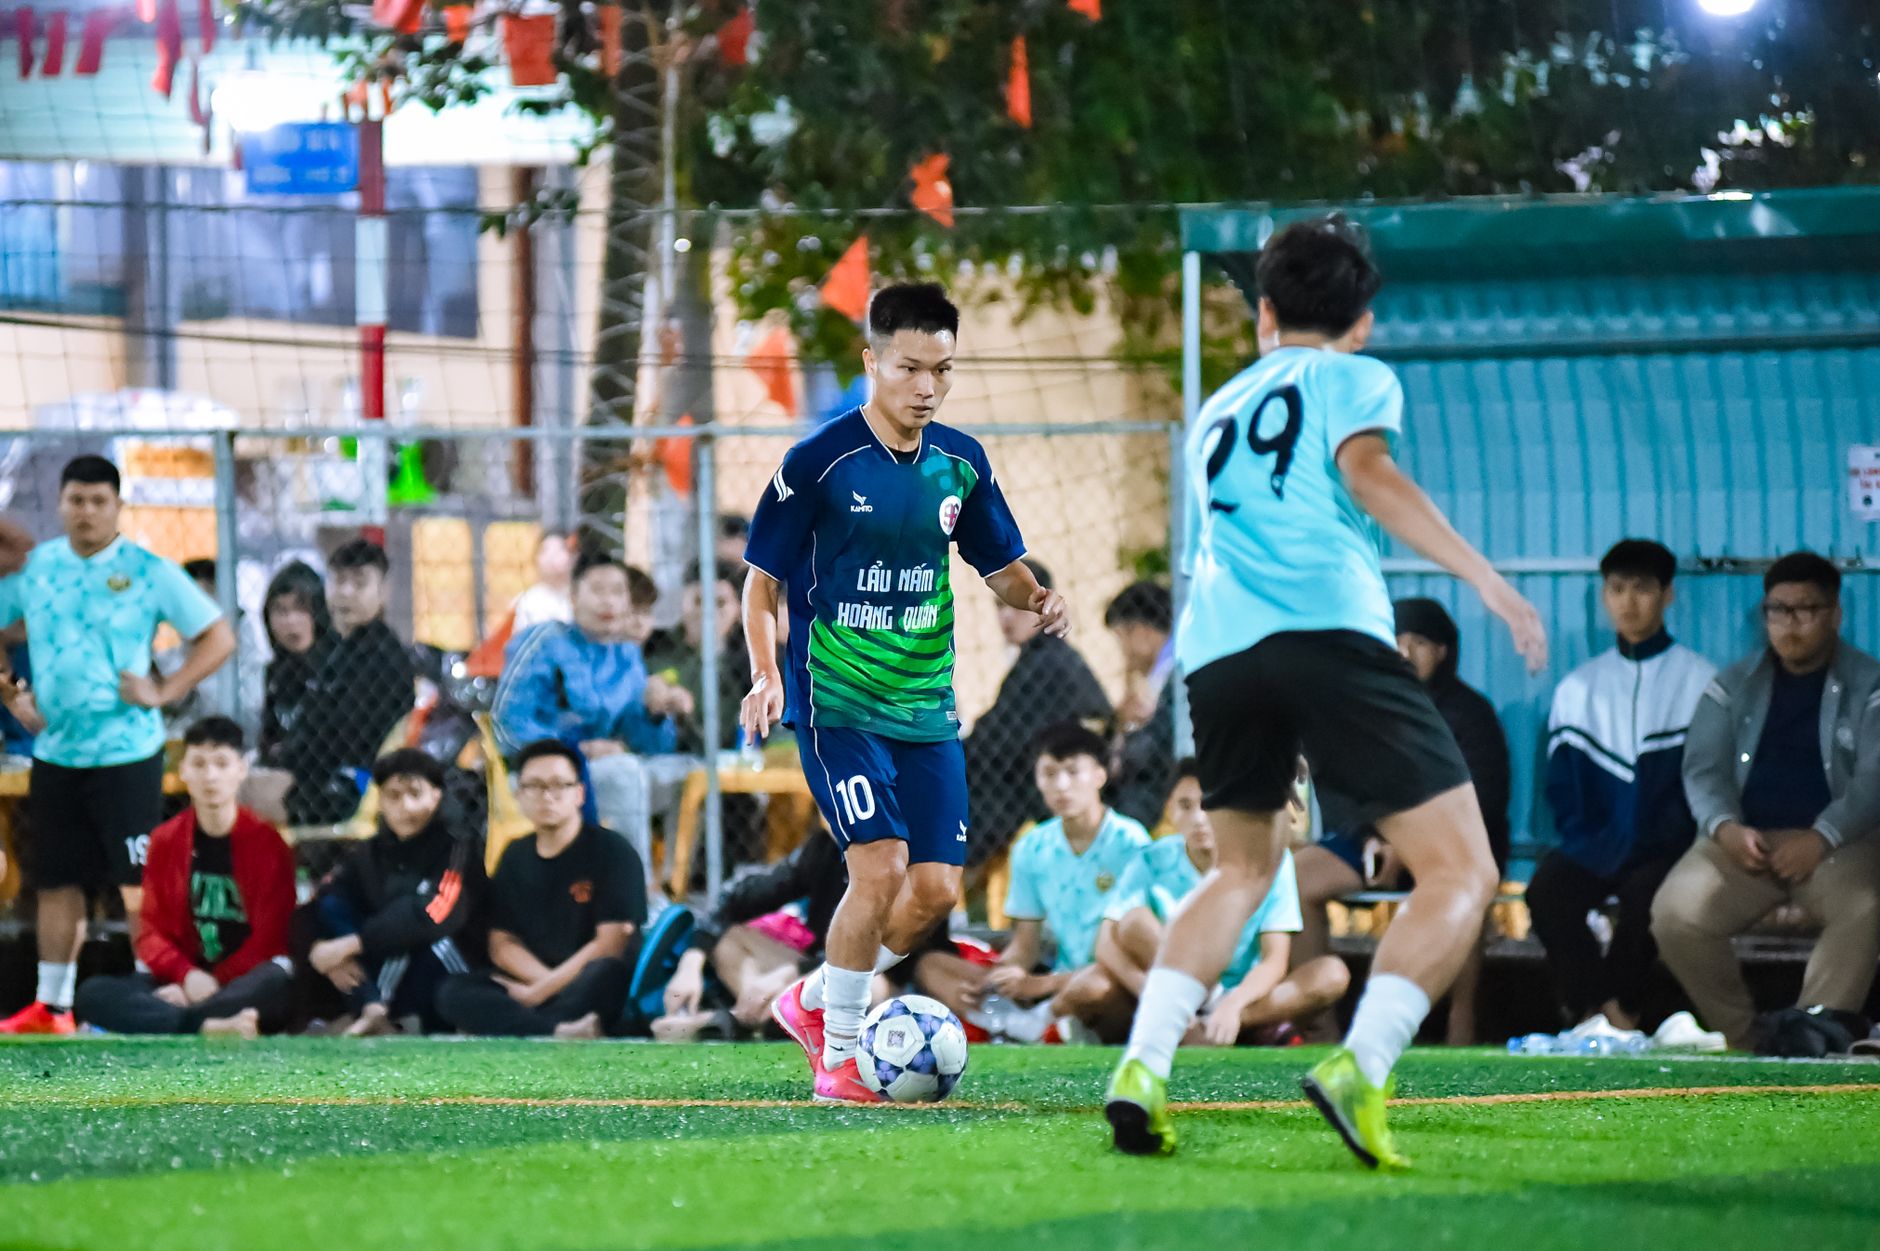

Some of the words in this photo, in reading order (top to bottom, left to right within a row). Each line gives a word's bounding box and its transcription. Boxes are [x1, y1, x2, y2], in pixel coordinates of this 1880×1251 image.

[1200, 384, 1304, 514] 29
[857, 560, 891, 592] LẨU
[898, 562, 934, 592] NẤM
[837, 601, 893, 629] HOÀNG
[903, 602, 938, 632] QUÂN
[836, 774, 875, 825] 10
